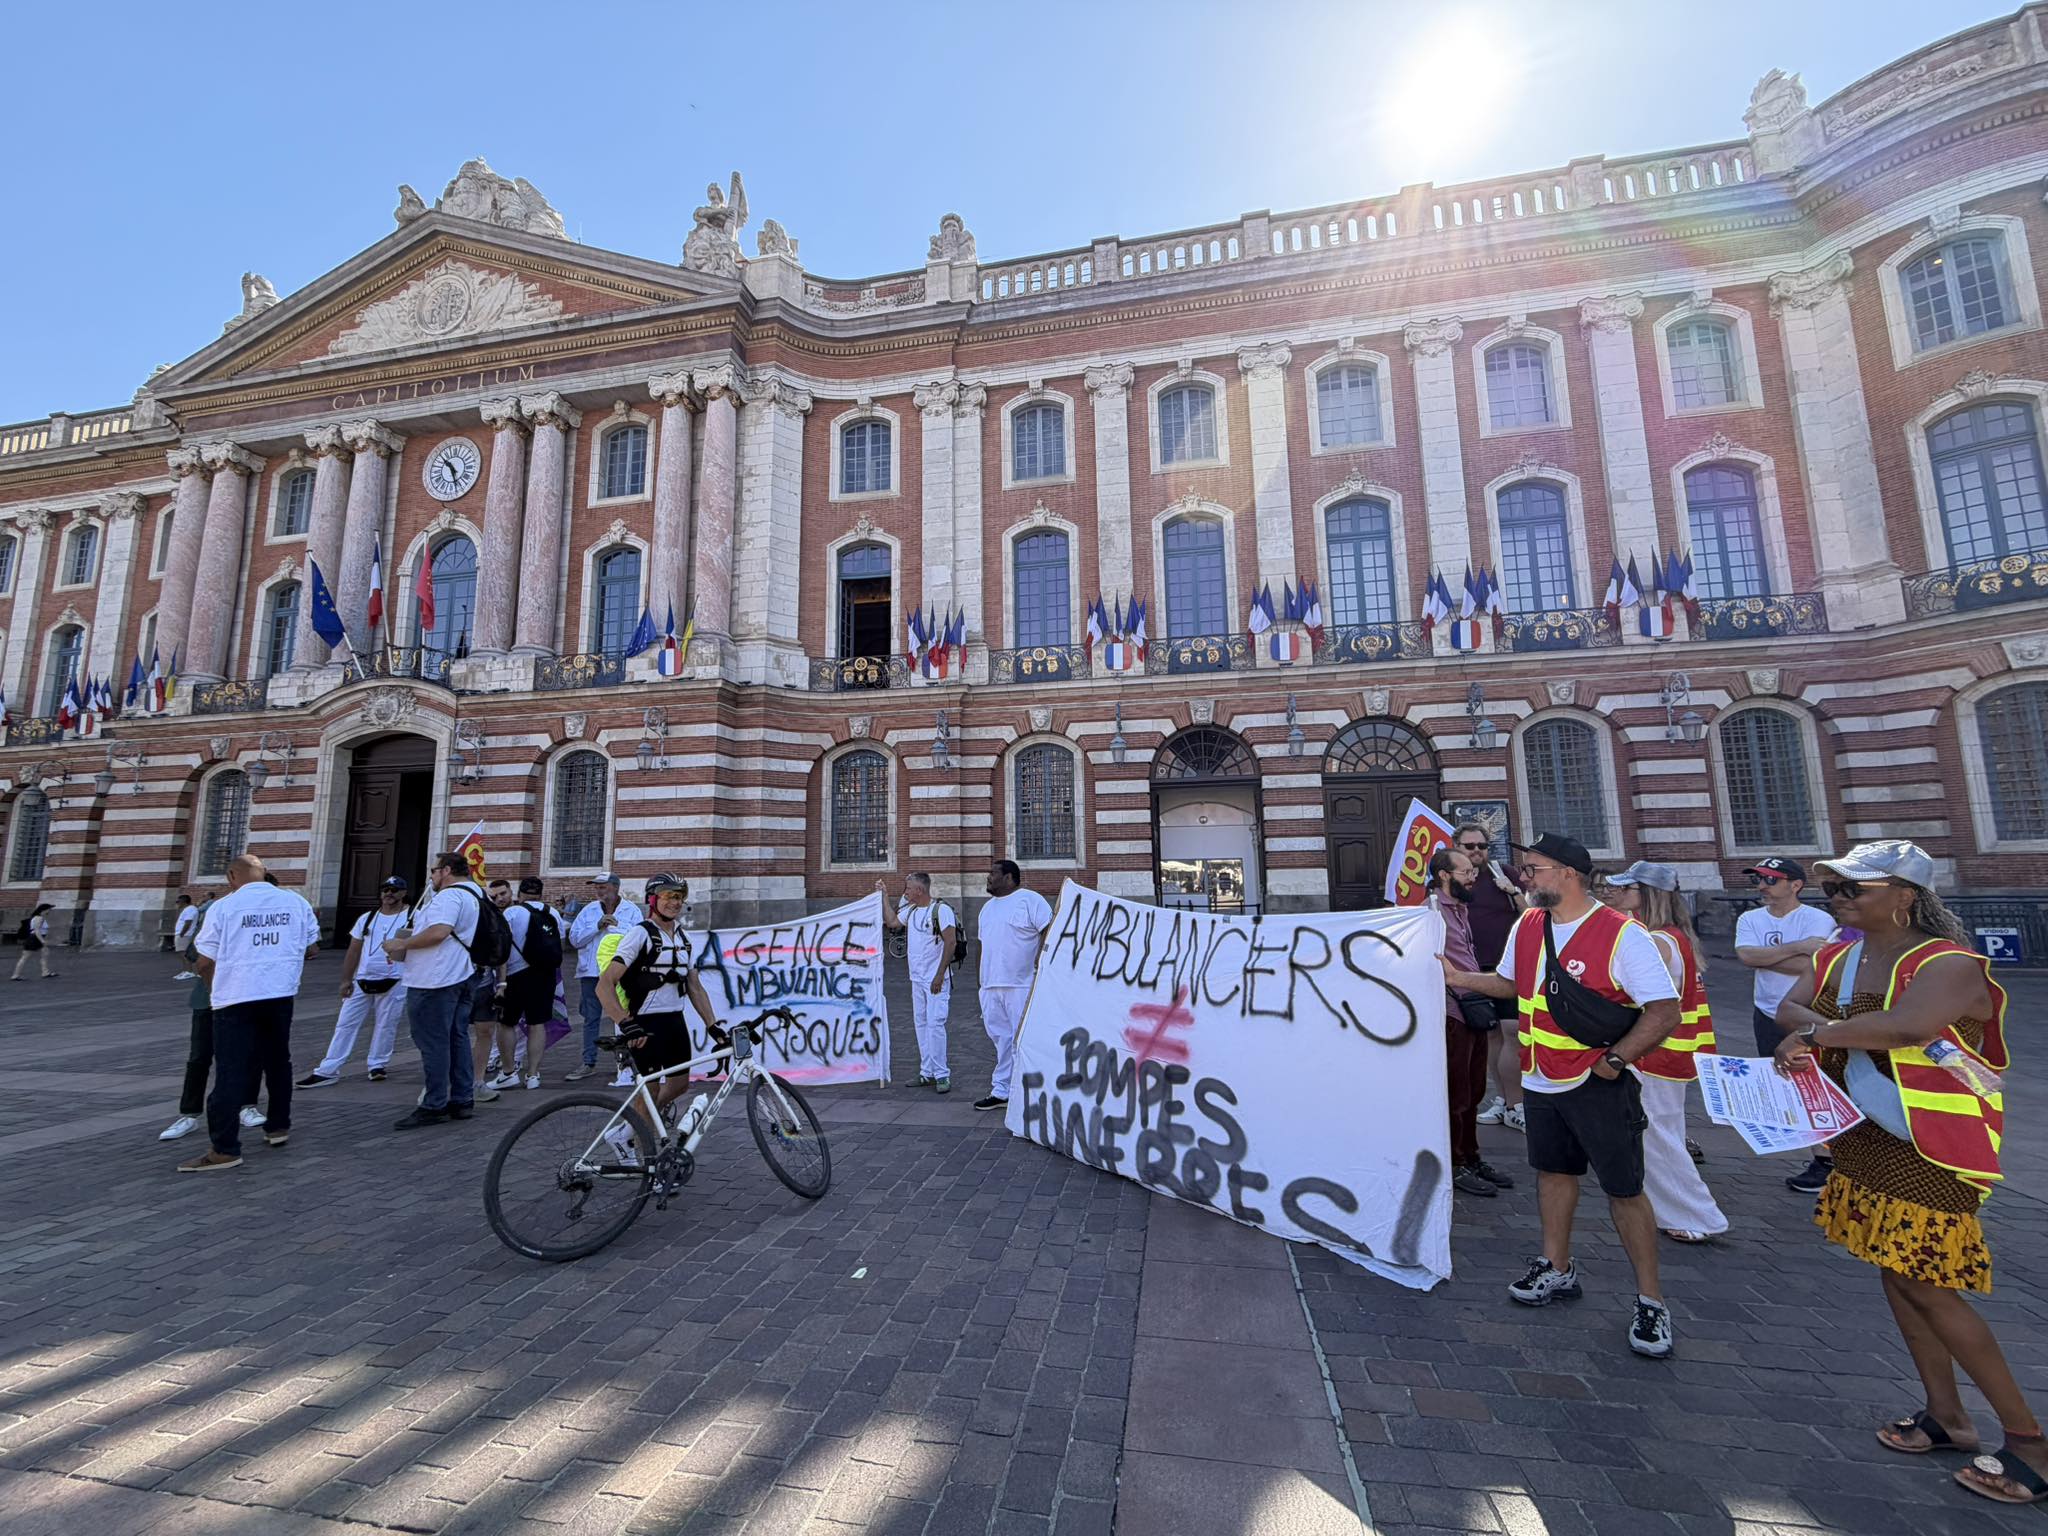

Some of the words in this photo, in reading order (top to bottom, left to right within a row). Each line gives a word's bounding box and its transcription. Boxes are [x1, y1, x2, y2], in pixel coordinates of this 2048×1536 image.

[332, 364, 536, 410] CAPITOLIUM
[241, 912, 290, 928] AMBULANCIER
[253, 932, 279, 946] CHU
[694, 921, 873, 1002] AGENCE
[1985, 936, 2005, 956] P
[1050, 893, 1417, 1046] AMBULANCIERS
[1056, 1027, 1247, 1164] POMPES
